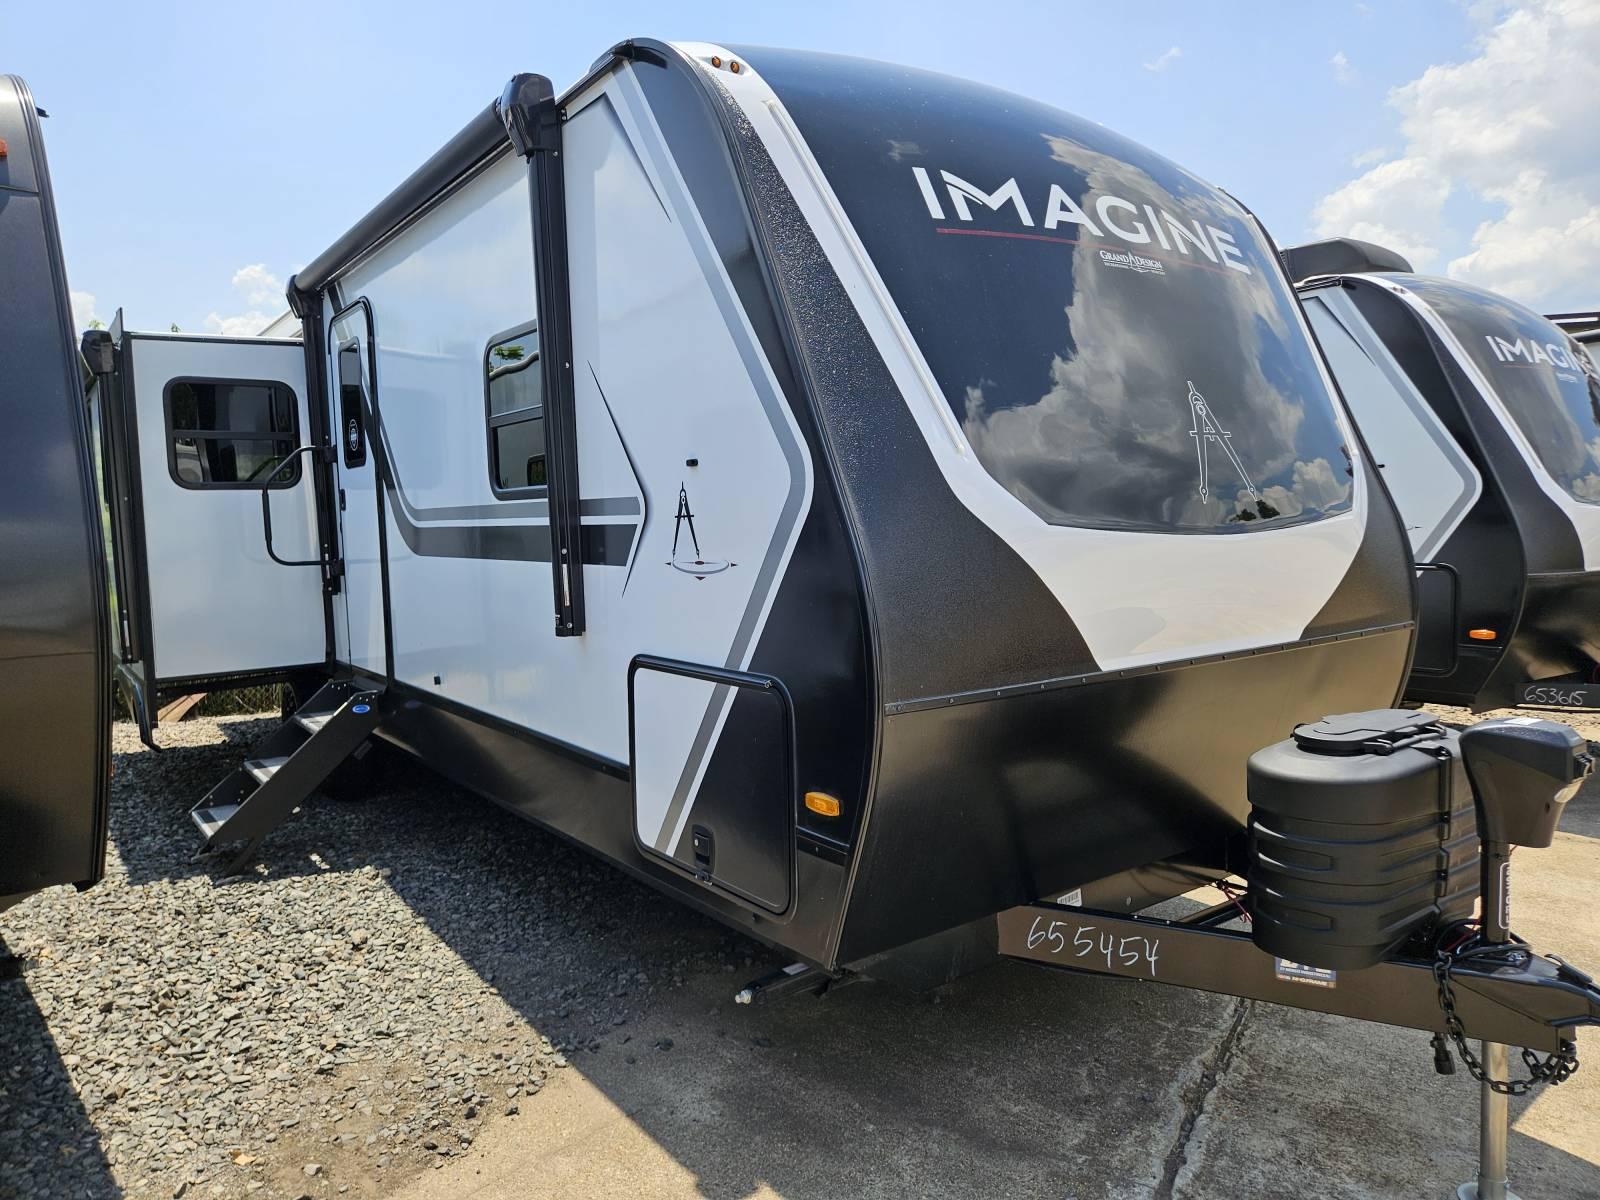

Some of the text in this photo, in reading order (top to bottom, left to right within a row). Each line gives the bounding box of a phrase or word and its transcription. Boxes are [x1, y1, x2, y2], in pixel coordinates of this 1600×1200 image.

[911, 166, 1252, 275] IMAGINE
[1100, 250, 1129, 263] GRAND
[1134, 255, 1163, 269] DESIGN
[1524, 685, 1588, 706] 653615
[1026, 915, 1159, 977] 655454
